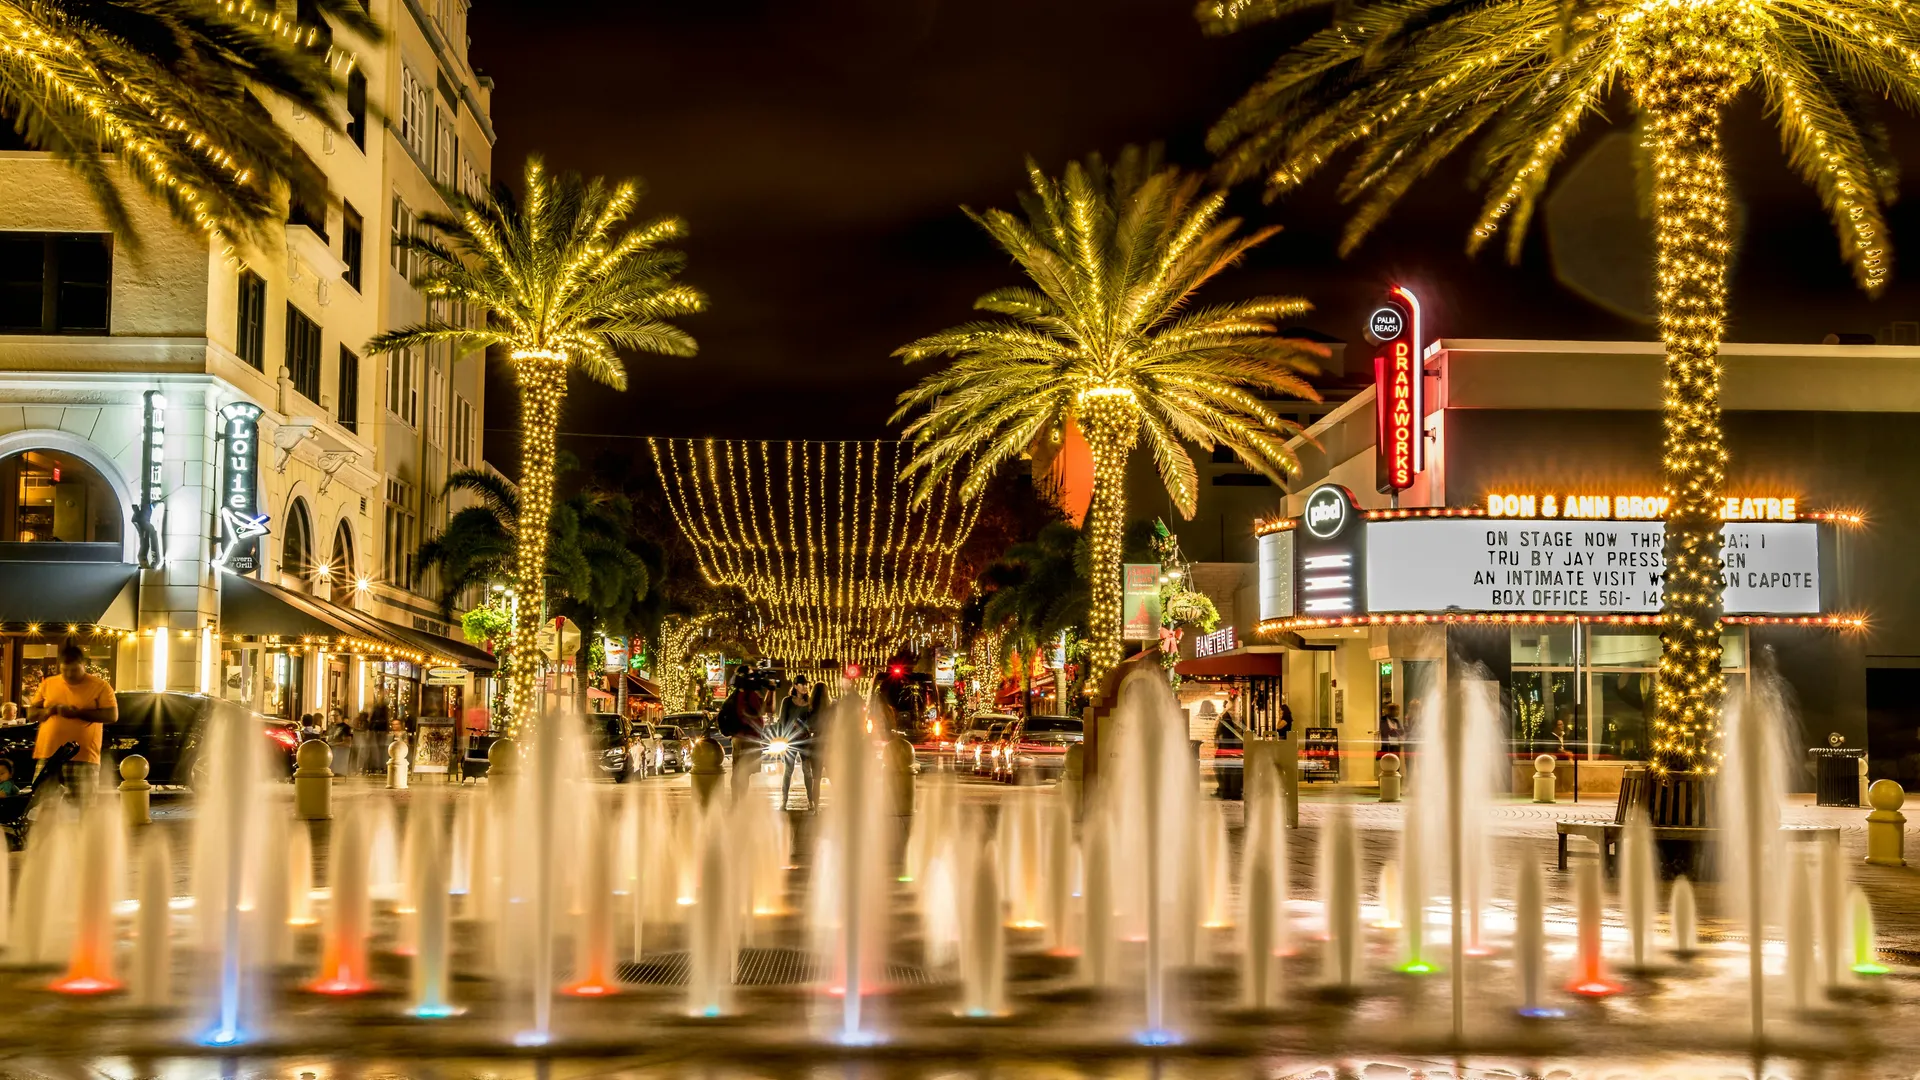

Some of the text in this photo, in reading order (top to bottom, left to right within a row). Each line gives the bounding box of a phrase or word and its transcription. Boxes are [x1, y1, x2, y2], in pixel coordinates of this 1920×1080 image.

[1375, 324, 1398, 332] BEACH
[1377, 316, 1396, 324] PALM
[222, 404, 259, 420] Bar
[1394, 343, 1410, 484] DRAMAWORKS
[230, 419, 250, 508] Louie
[1311, 499, 1340, 527] pbd
[1488, 495, 1536, 517] DON
[1541, 494, 1559, 517] &
[1563, 495, 1610, 517] ANN
[1486, 531, 1508, 546] ON
[1520, 531, 1573, 547] STAGE
[1585, 532, 1618, 547] NOW
[1631, 532, 1662, 548] THR
[1487, 550, 1519, 566] TRU
[1531, 551, 1554, 566] BY
[1563, 551, 1595, 566] JAY
[1727, 553, 1746, 568] EN
[1473, 570, 1496, 585] AN
[1507, 570, 1584, 586] INTIMATE
[1593, 571, 1637, 586] VISIT
[1748, 572, 1812, 588] CAPOTE
[1492, 590, 1525, 606] BOX
[1532, 590, 1588, 606] OFFICE
[1196, 626, 1234, 658] PANETERIE
